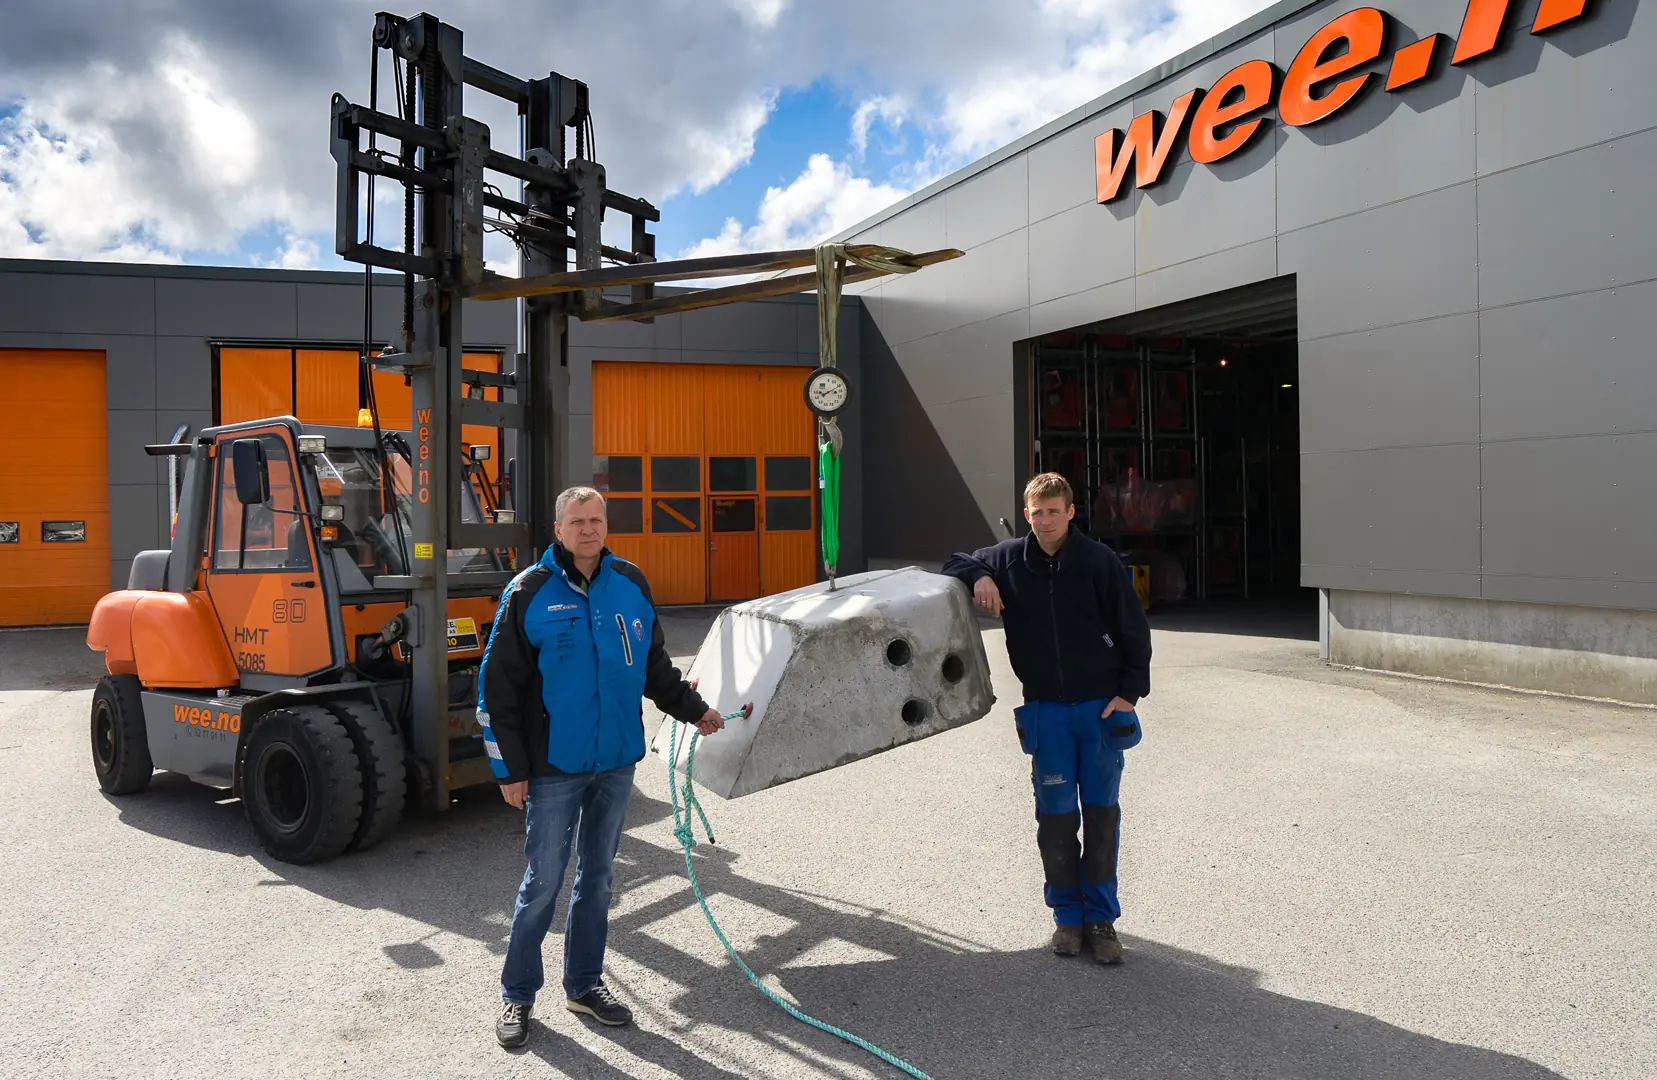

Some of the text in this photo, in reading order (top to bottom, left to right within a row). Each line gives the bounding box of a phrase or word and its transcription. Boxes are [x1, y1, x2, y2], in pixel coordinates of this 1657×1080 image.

[416, 408, 432, 503] wee.no
[272, 598, 306, 624] 80
[234, 627, 269, 645] HMT
[238, 652, 266, 672] 5085
[173, 703, 240, 733] wee.no
